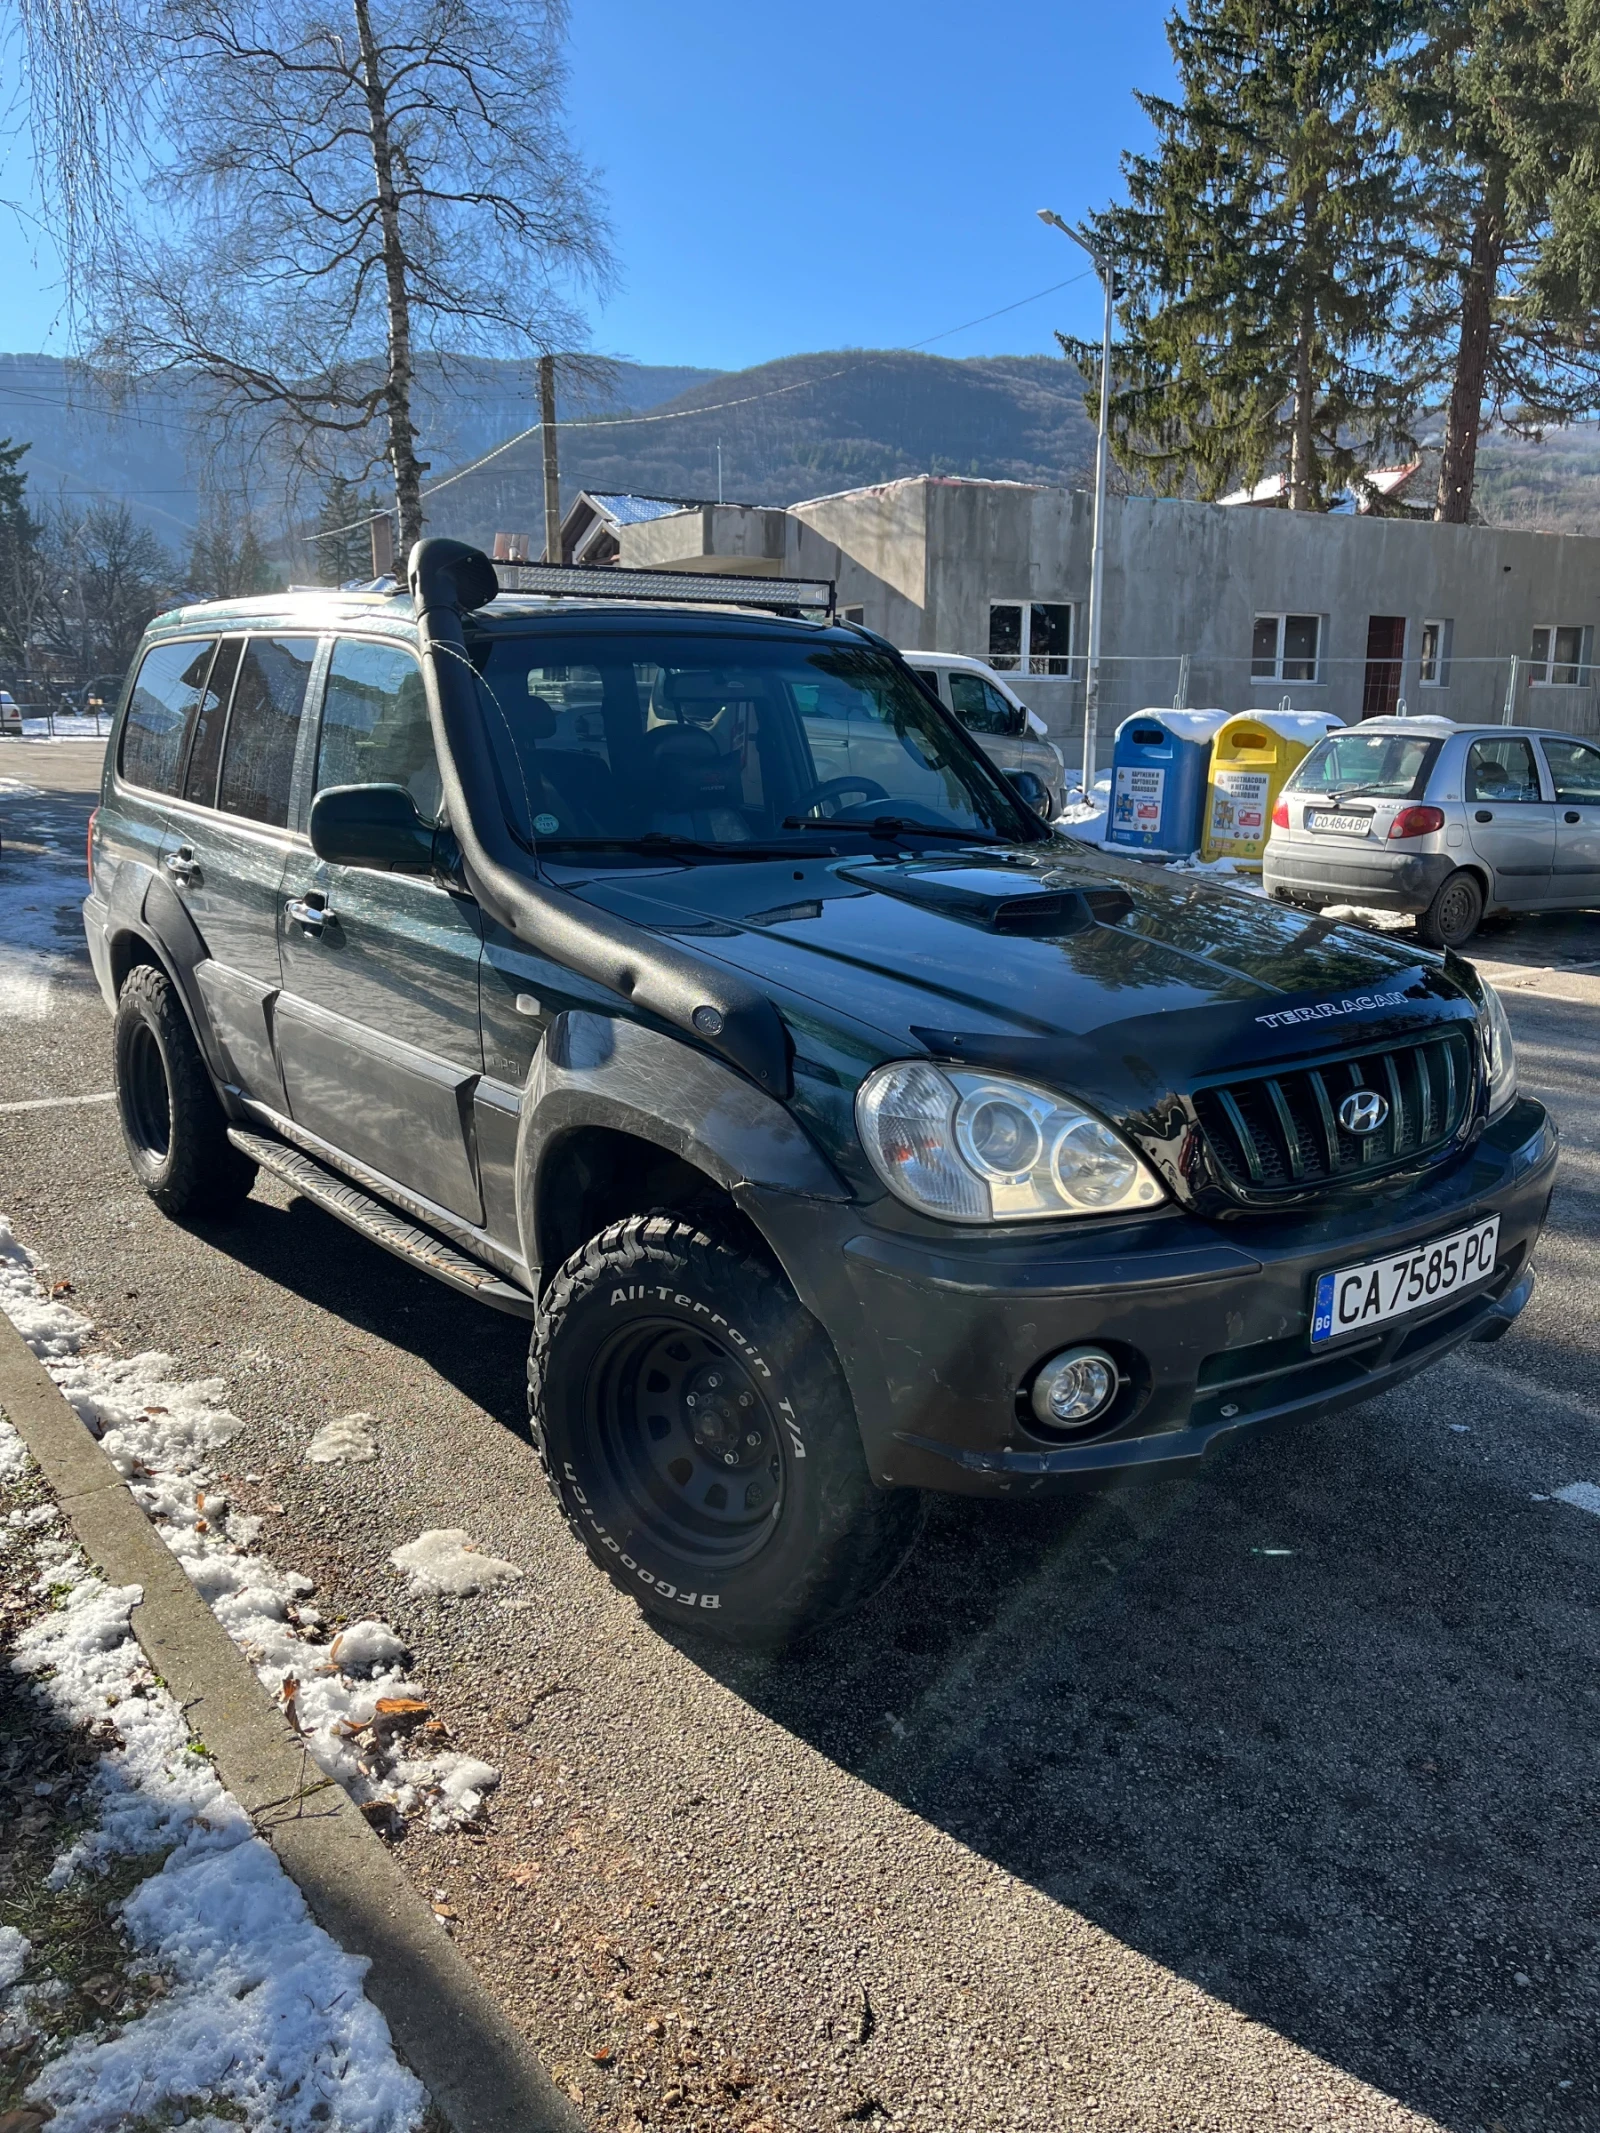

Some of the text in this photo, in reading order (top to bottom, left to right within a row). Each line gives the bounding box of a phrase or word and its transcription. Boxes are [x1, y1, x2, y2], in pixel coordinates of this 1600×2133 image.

[1329, 816, 1353, 830] 4864
[1354, 819, 1370, 831] BP
[1255, 991, 1409, 1029] TERRACAN
[1338, 1226, 1494, 1324] CA 7585 PC
[1315, 1315, 1331, 1332] BG
[609, 1285, 806, 1459] All-Terrain T/A
[563, 1461, 722, 1609] BFGoodrich
